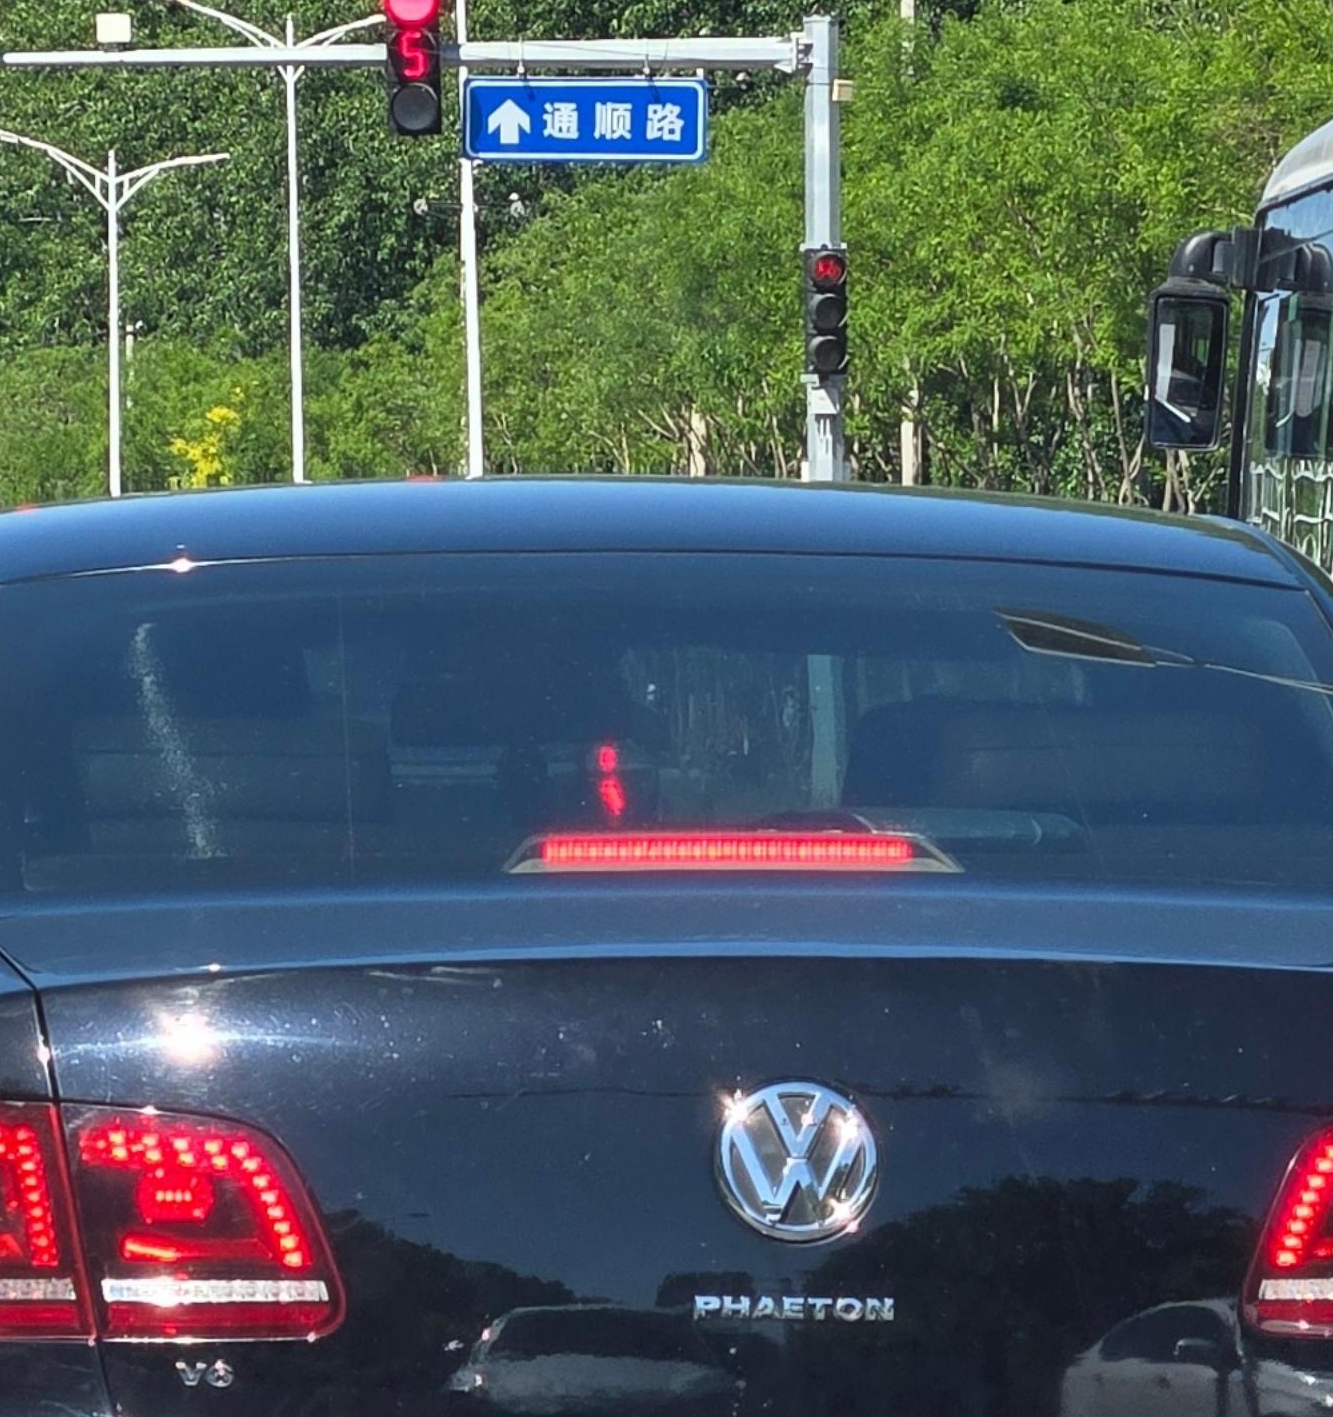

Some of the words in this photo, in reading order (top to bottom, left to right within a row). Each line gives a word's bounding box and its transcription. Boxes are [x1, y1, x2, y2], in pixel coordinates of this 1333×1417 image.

[401, 31, 428, 78] 5
[543, 102, 685, 142] 通顺路
[693, 1294, 895, 1322] PHAETON
